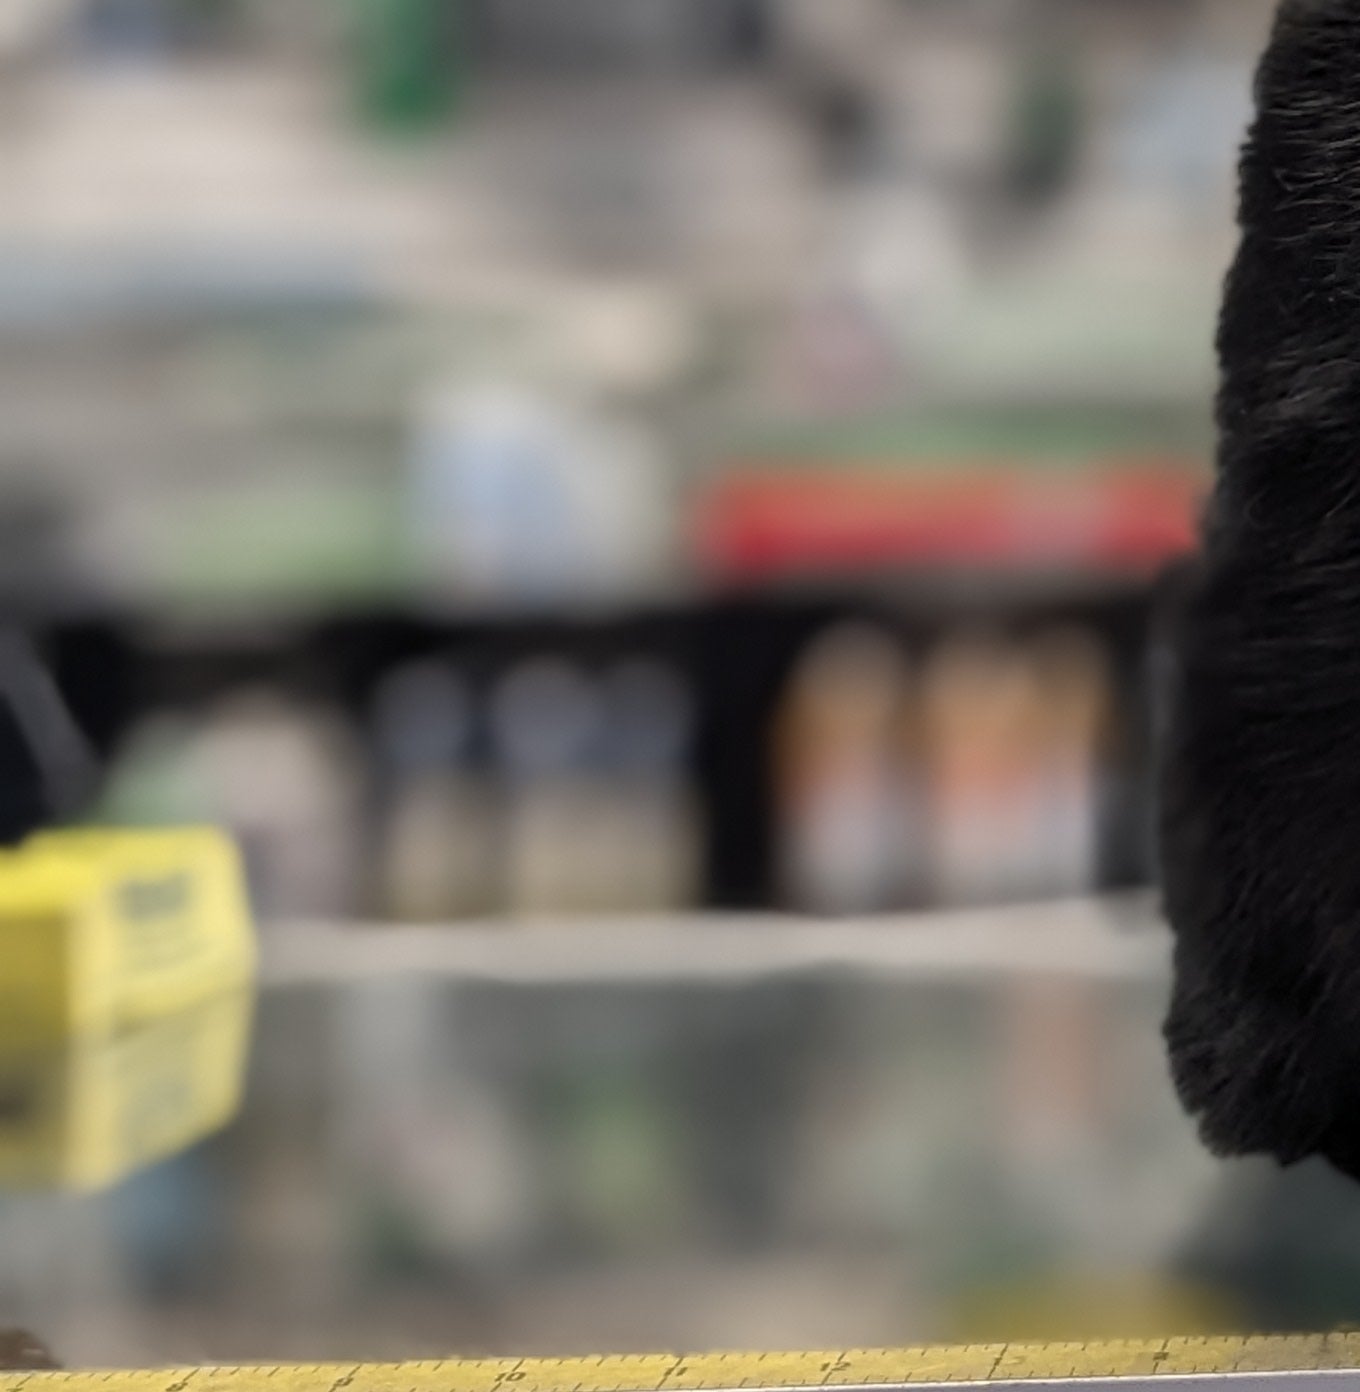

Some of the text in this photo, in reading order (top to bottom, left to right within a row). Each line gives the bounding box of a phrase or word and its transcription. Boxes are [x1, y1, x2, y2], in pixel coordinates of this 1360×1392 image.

[334, 1376, 354, 1388] 9
[494, 1371, 527, 1382] 10
[664, 1366, 688, 1377] 11
[820, 1361, 851, 1372] 12
